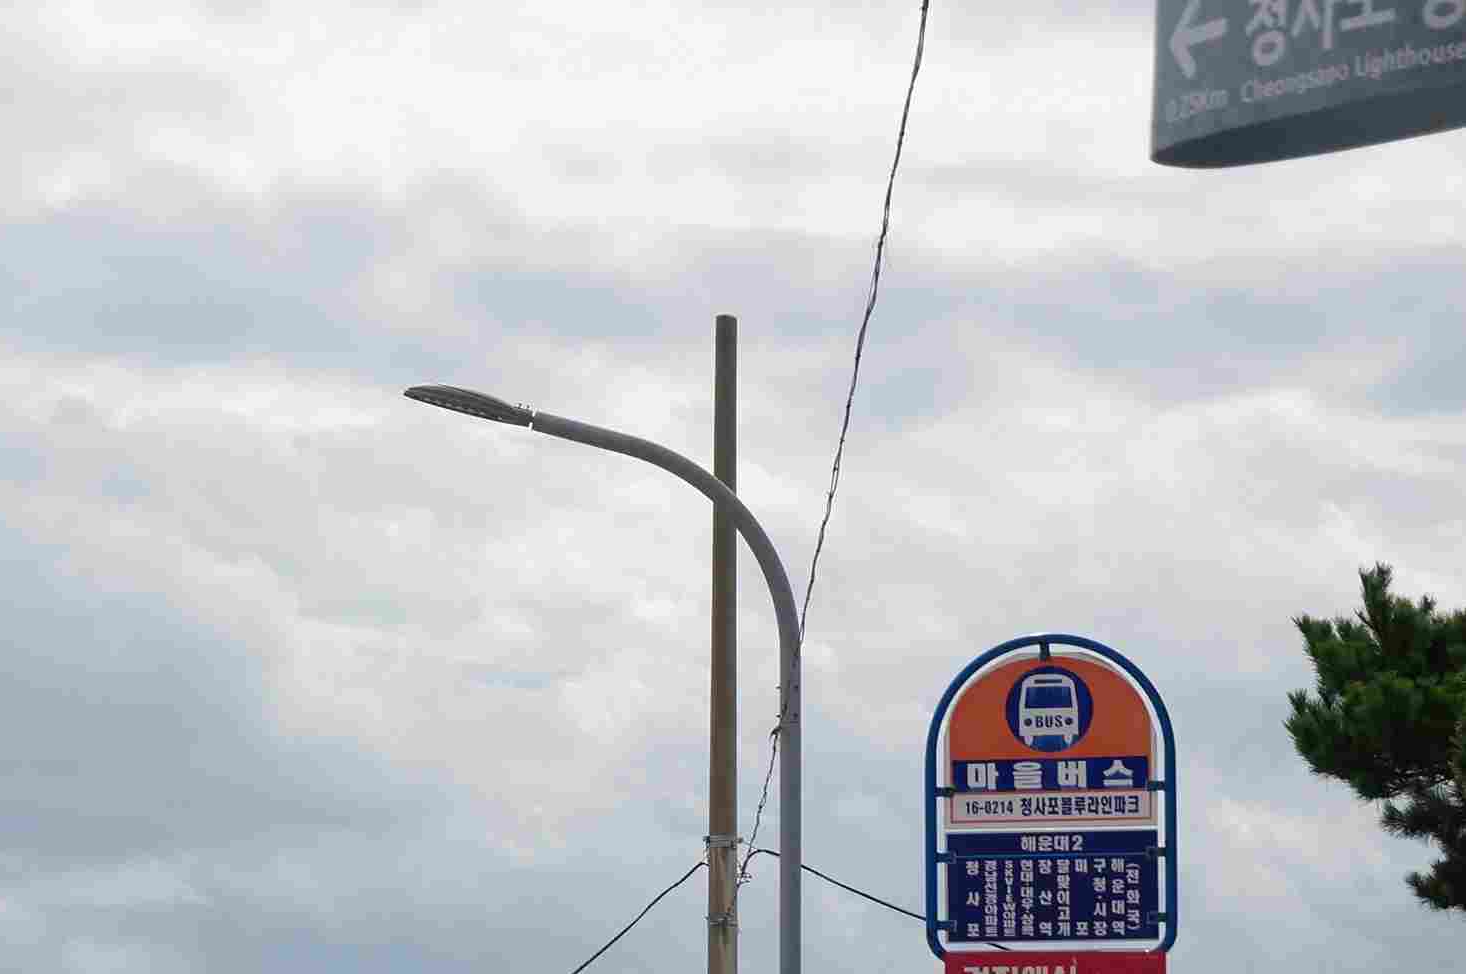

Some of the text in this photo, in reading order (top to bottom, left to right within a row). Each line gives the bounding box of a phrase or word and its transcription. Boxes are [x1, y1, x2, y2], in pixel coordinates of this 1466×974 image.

[1034, 714, 1064, 728] BUS
[965, 760, 1134, 790] 마을버스
[965, 795, 1140, 816] 16-0214 청사포블루라인파크
[1020, 835, 1084, 851] 해운대2
[965, 859, 981, 937] 청사포
[1110, 858, 1126, 936] 해운대역
